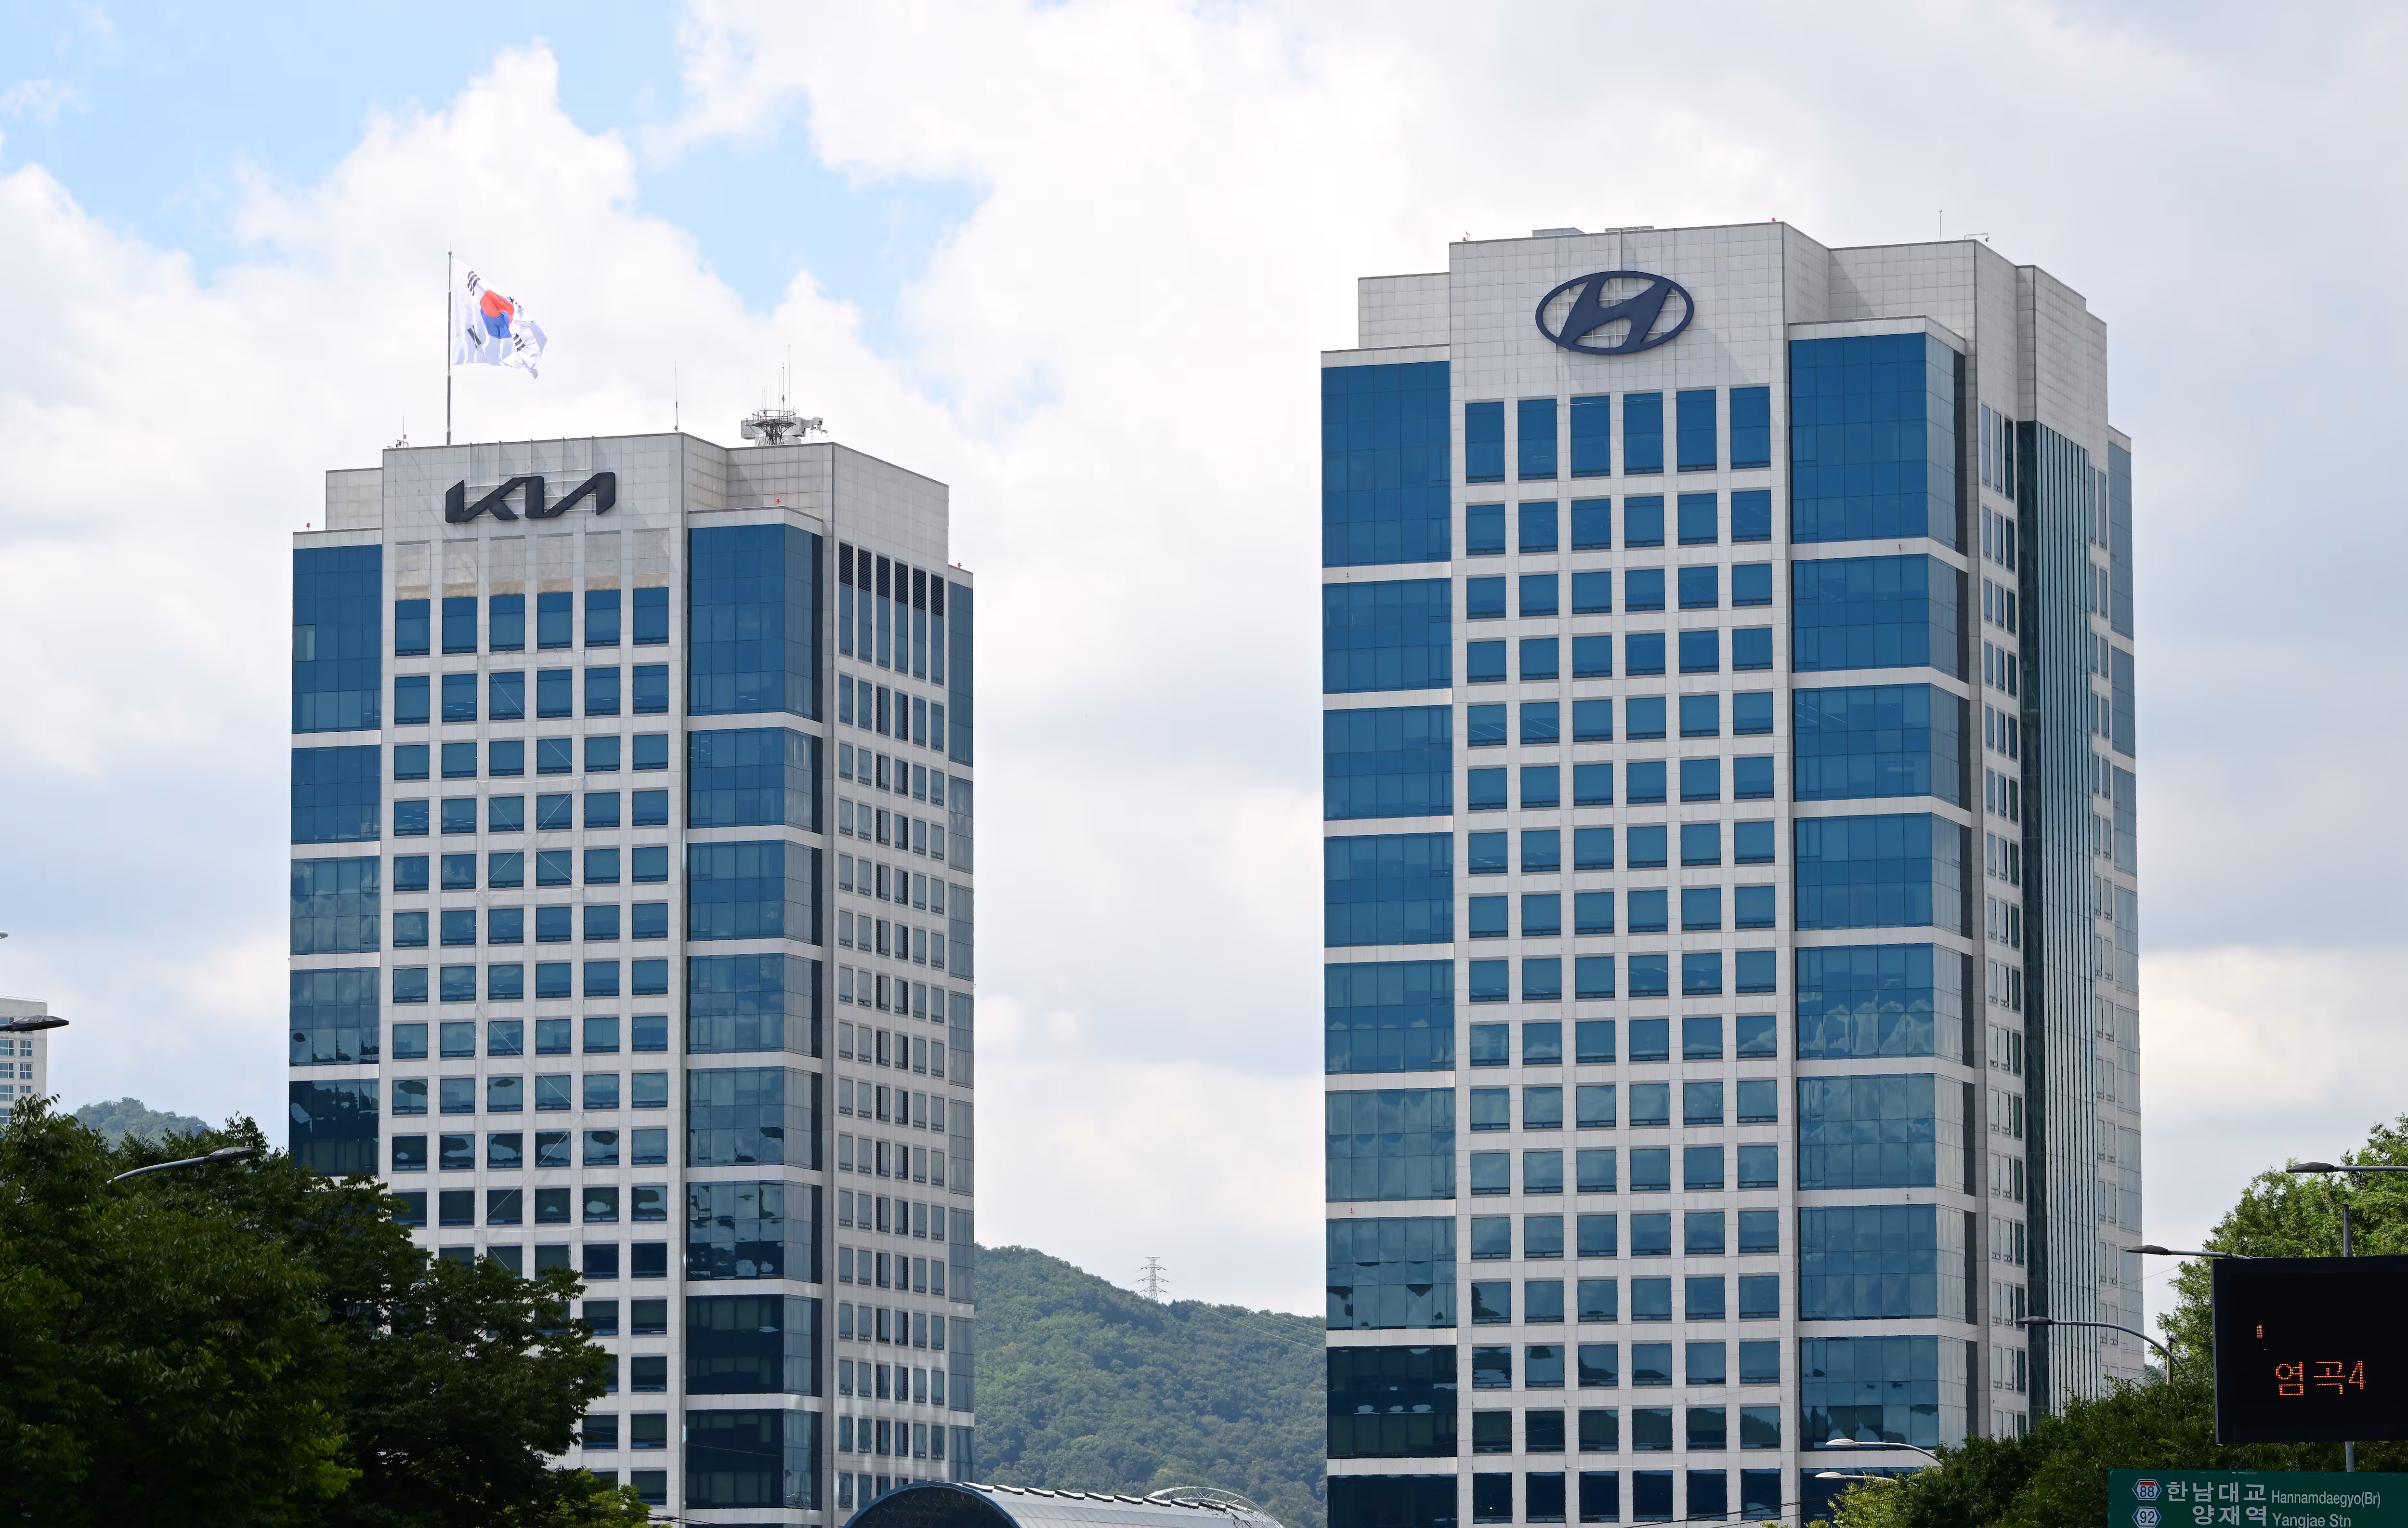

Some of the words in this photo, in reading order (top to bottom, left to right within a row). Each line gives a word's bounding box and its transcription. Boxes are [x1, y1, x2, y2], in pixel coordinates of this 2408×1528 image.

[2276, 1361, 2367, 1396] 염곡4
[2140, 1486, 2155, 1497] 88
[2166, 1481, 2266, 1502] 한남대교
[2271, 1490, 2381, 1508] Hannamdaegyo(Br)
[2140, 1511, 2155, 1524] 92
[2192, 1505, 2266, 1526] 양재역
[2272, 1513, 2326, 1528] Yangjae
[2329, 1514, 2351, 1527] Stn
